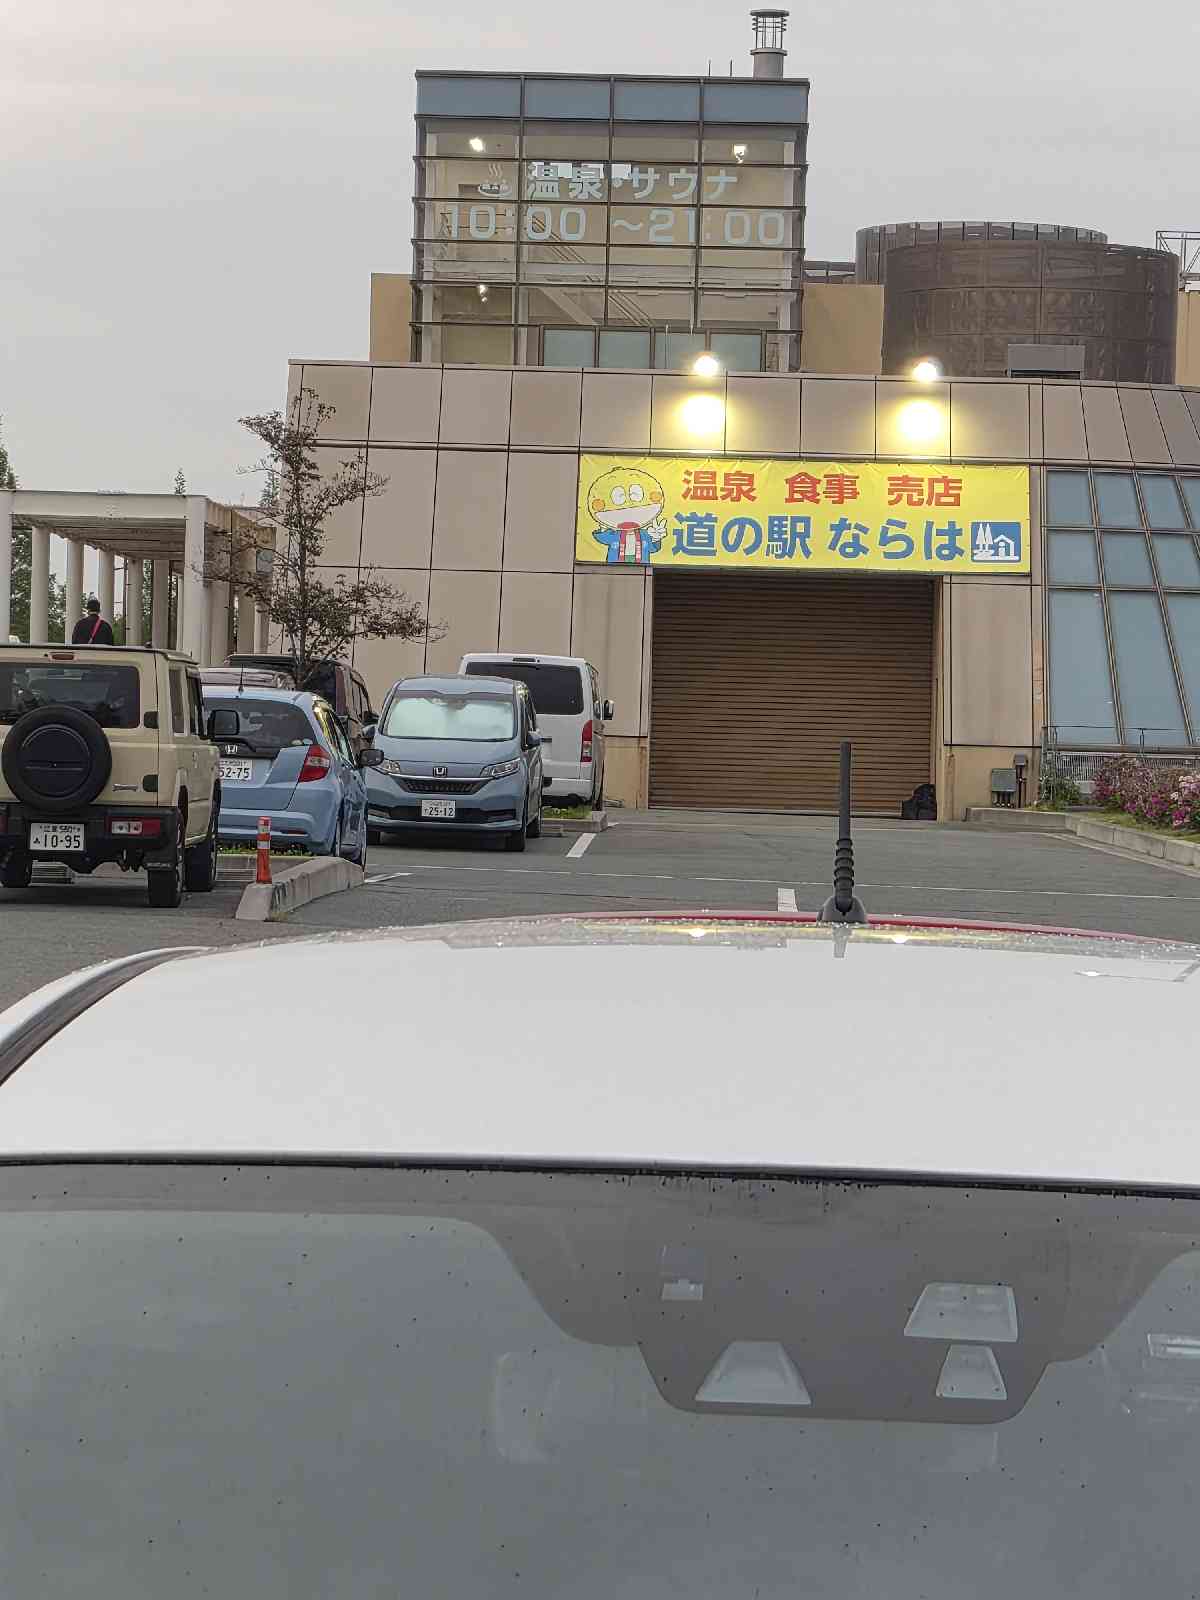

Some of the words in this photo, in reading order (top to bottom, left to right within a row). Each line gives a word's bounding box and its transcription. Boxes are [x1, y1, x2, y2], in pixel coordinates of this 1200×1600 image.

[681, 469, 757, 502] 温泉
[784, 472, 860, 504] 食事
[887, 475, 963, 507] 売店
[671, 512, 812, 560] 道の駅
[828, 517, 965, 561] ならは
